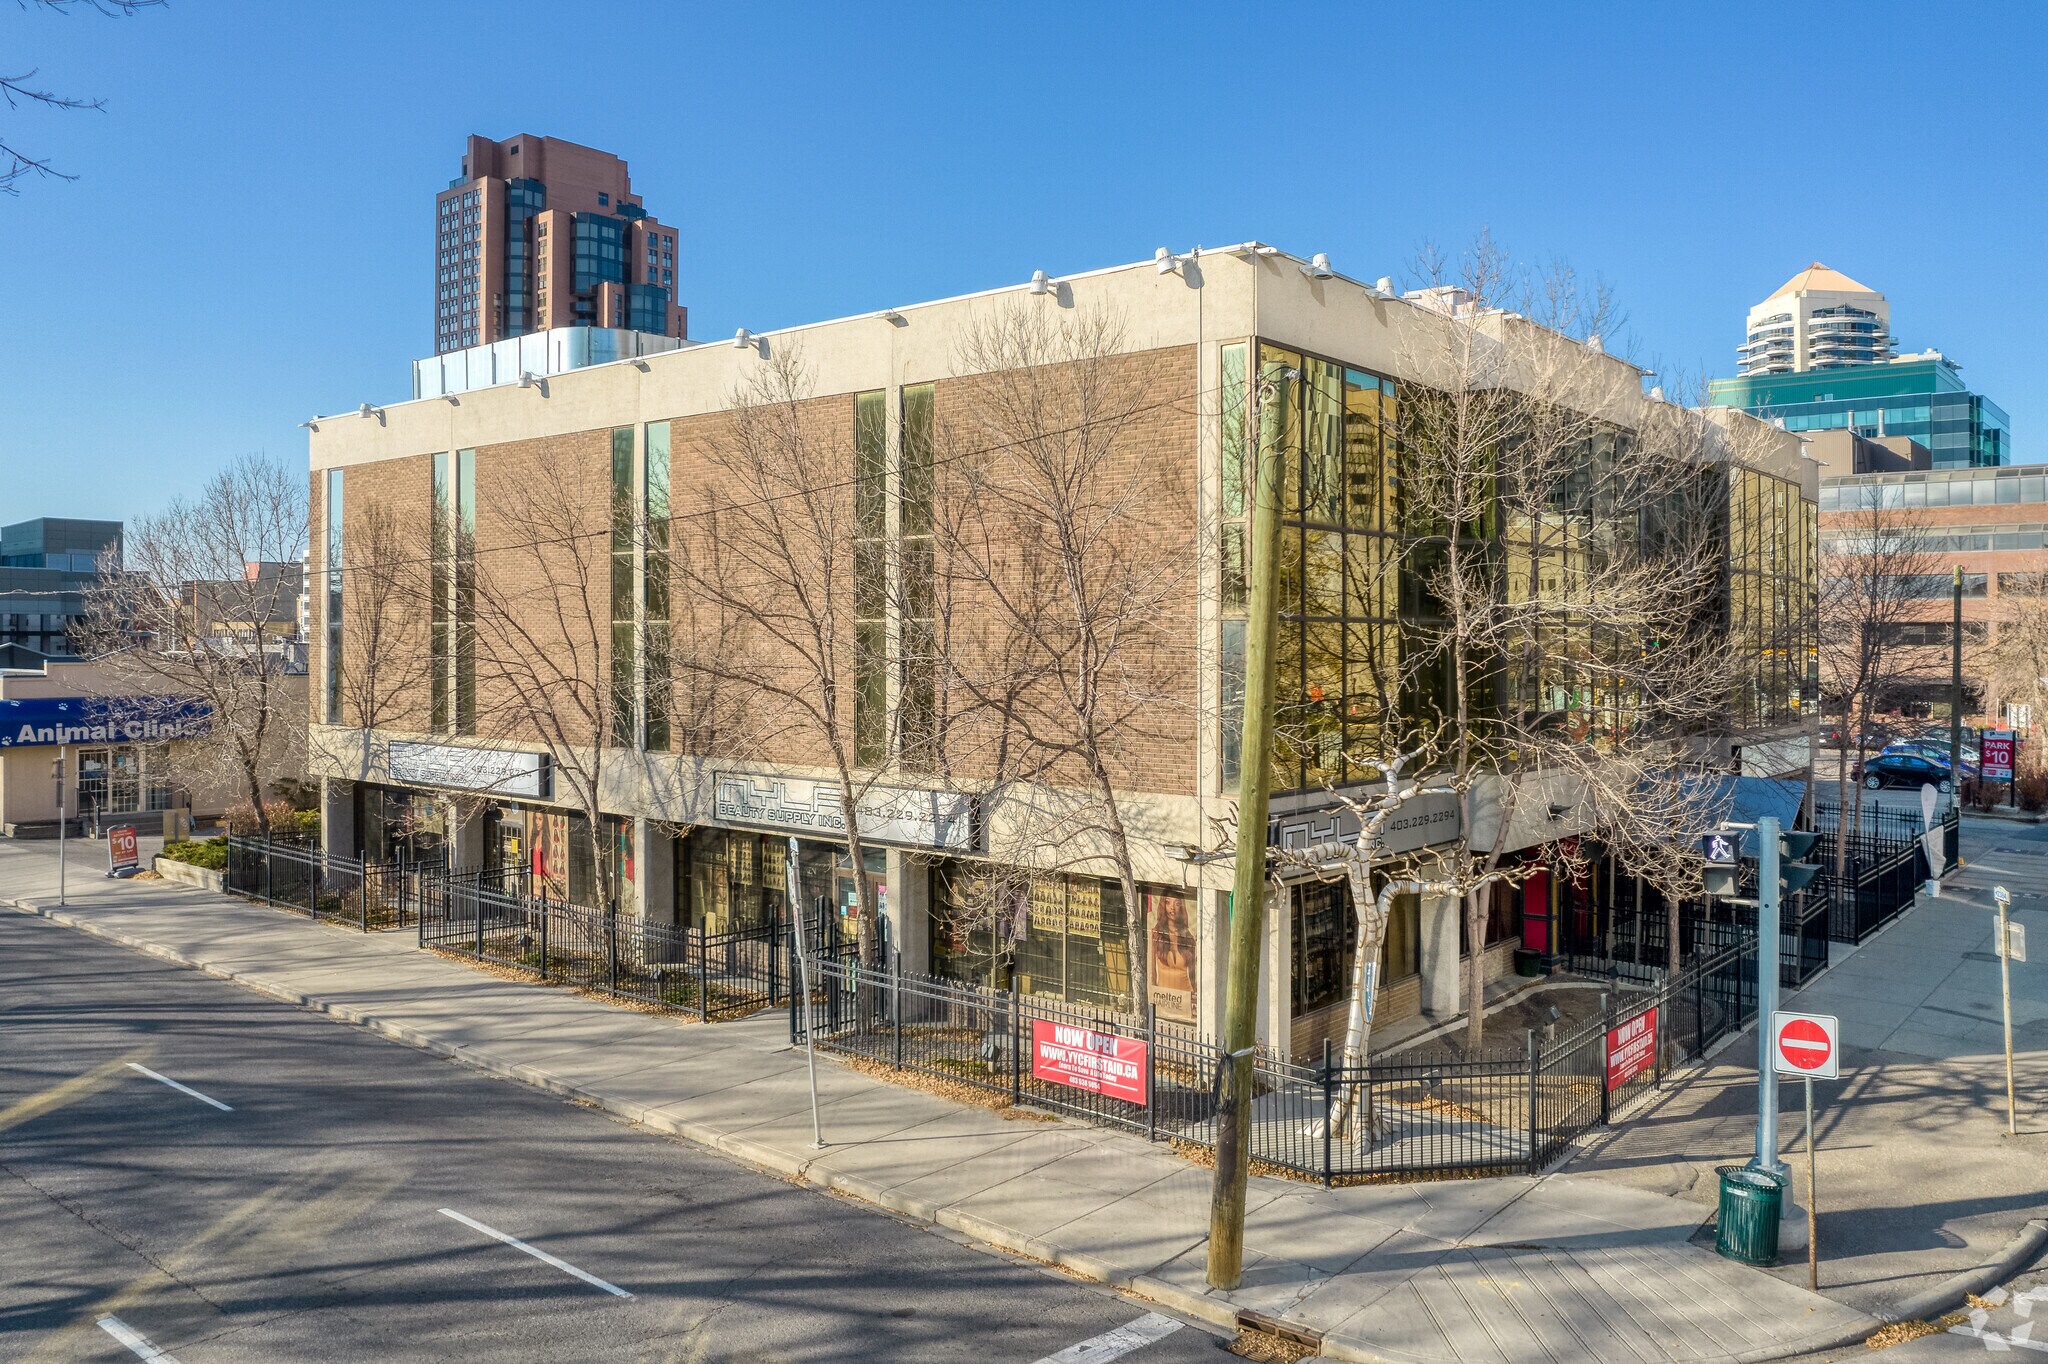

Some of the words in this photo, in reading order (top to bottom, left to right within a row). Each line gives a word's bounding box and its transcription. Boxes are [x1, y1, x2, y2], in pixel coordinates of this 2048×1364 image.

[16, 721, 115, 743] Animal
[124, 719, 197, 739] Clinic
[1985, 741, 2010, 750] PARK
[1985, 750, 2009, 764] $10
[719, 803, 765, 819] BEAUTY
[767, 809, 815, 825] SUPPLY
[818, 815, 846, 829] INC.
[1390, 810, 1455, 832] 403.229.2294
[112, 835, 135, 850] $10
[1153, 991, 1183, 1003] melted
[1055, 1025, 1084, 1048] NOW
[1086, 1030, 1119, 1056] OPEN
[1040, 1044, 1138, 1080] WWW.YYCFIRSTAID.CA
